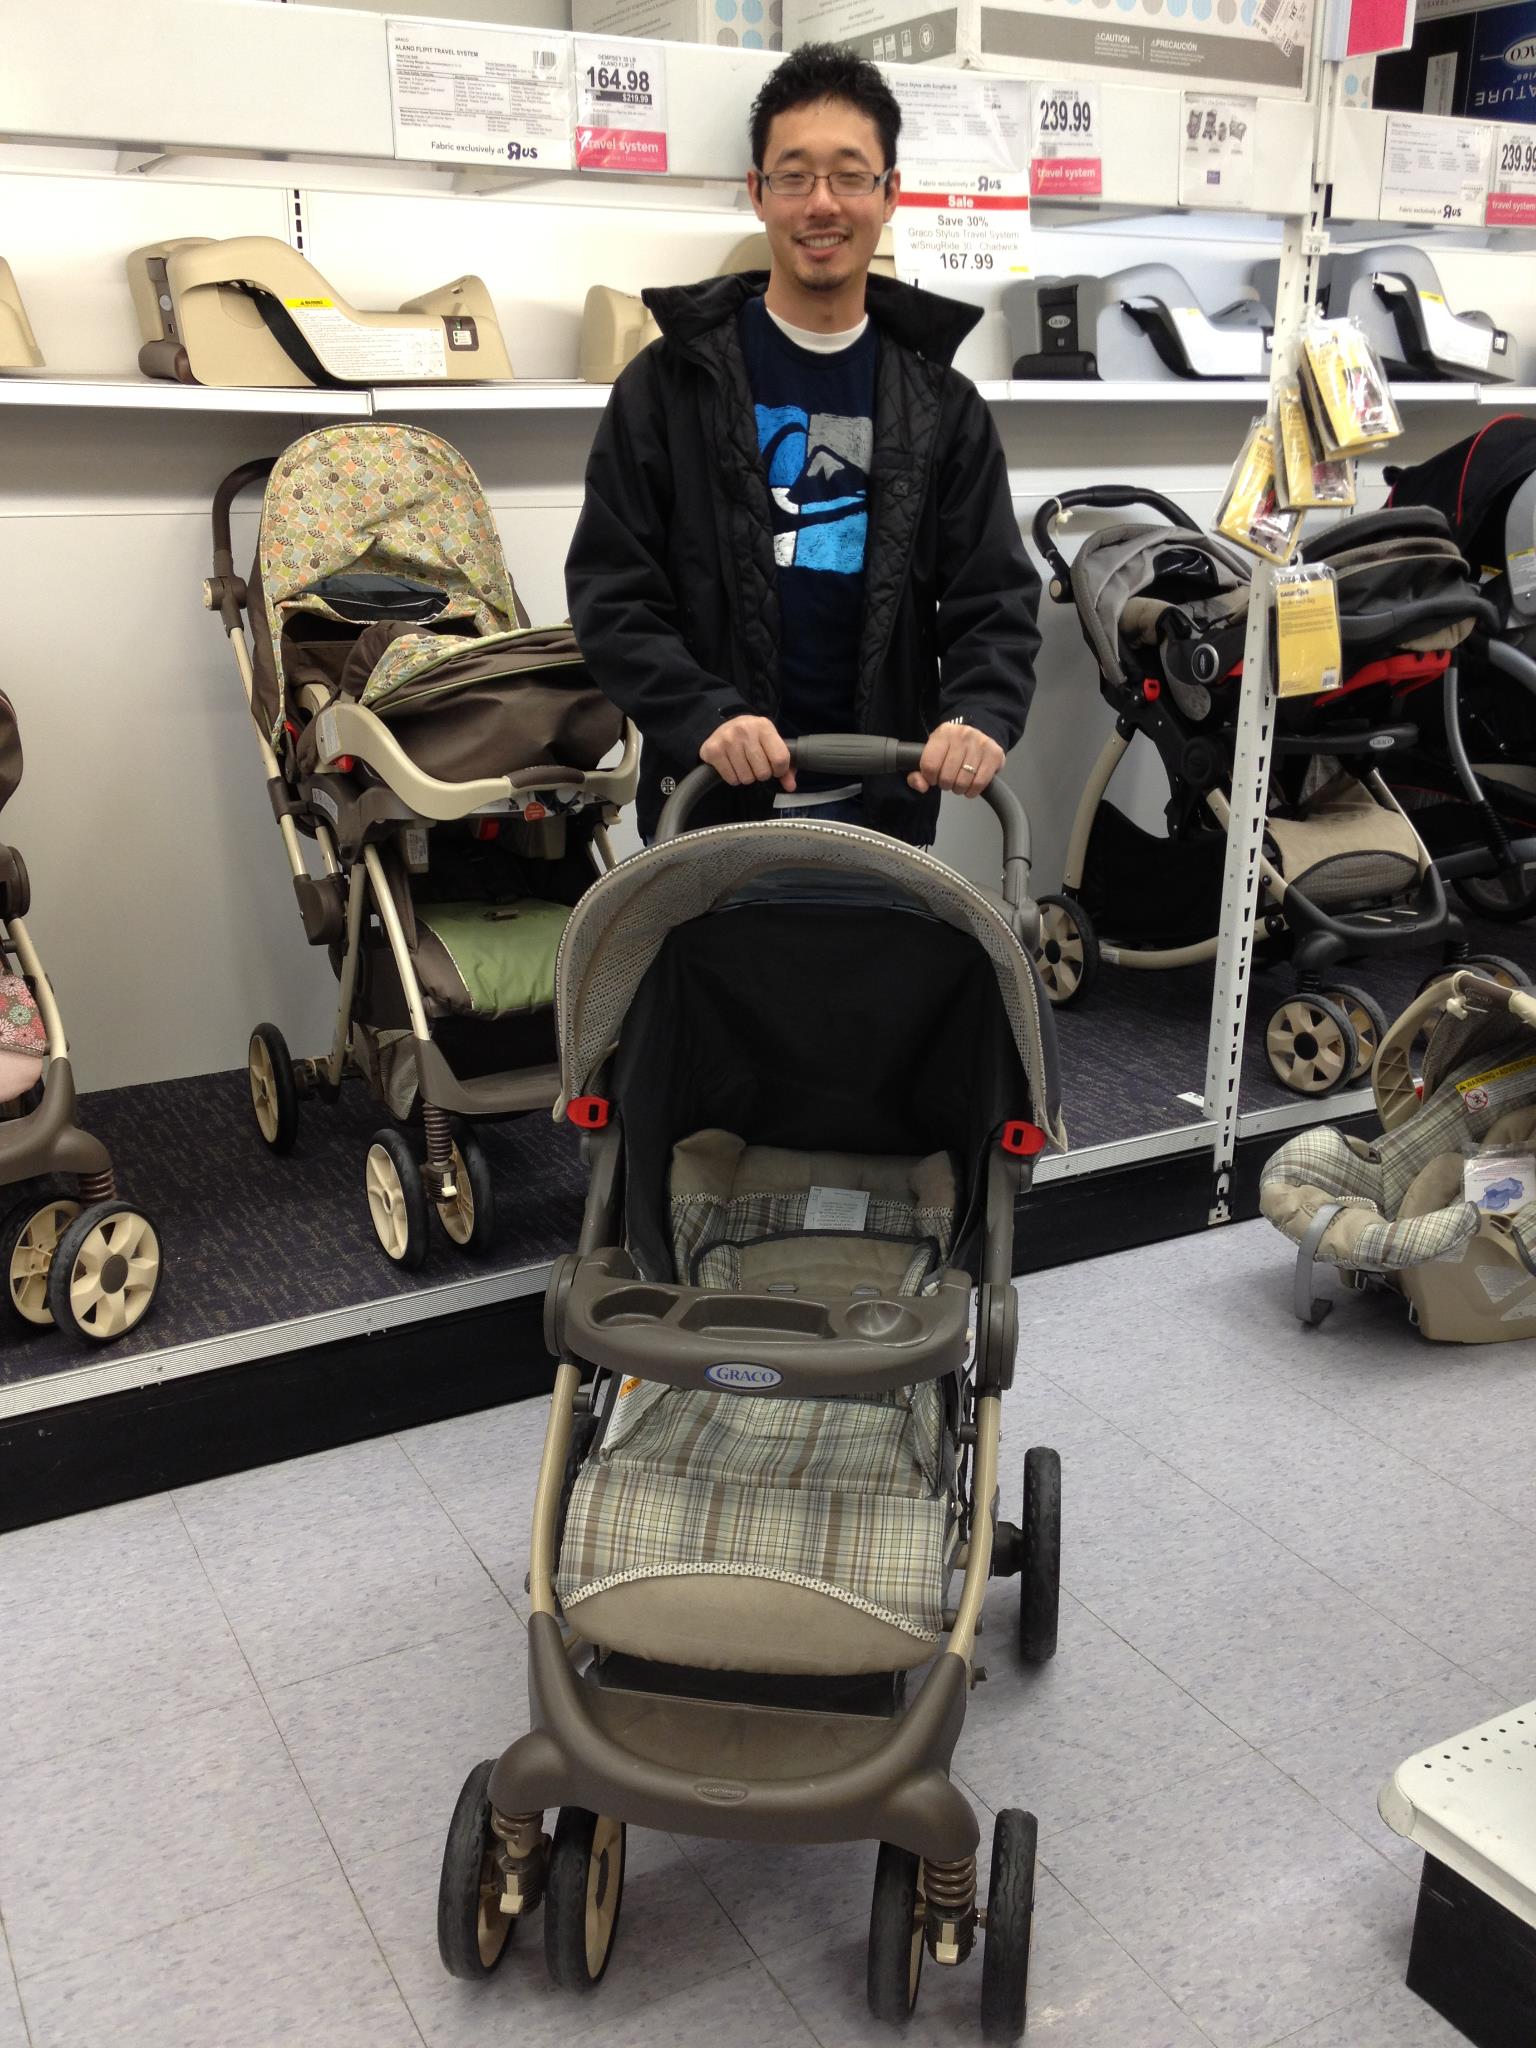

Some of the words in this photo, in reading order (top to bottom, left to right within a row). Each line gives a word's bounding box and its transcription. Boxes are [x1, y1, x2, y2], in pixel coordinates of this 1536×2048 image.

[1100, 33, 1130, 44] CAUTION
[1155, 38, 1198, 52] PRECAUCIÓN
[587, 66, 650, 92] 164.98
[622, 92, 649, 103] $219.99
[1040, 99, 1091, 132] 239.99
[431, 141, 454, 151] Fabric
[456, 143, 495, 155] exclusively
[583, 138, 616, 150] travel
[619, 140, 658, 154] system
[1037, 165, 1063, 178] travel
[1065, 167, 1096, 181] system
[919, 179, 936, 187] Fabric
[938, 180, 968, 188] exclusively
[948, 194, 974, 208] Sale
[1492, 200, 1512, 209] travel
[1513, 201, 1536, 213] system
[937, 214, 963, 226] Save
[966, 216, 989, 228] 30%
[908, 227, 933, 237] Graco
[935, 228, 960, 240] Stylus
[963, 229, 987, 239] Travel
[989, 230, 1019, 240] System
[910, 240, 960, 251] w/SnugRide
[979, 242, 1018, 251] Chadwick
[939, 252, 994, 270] 167.99
[716, 1366, 775, 1383] GRACO
